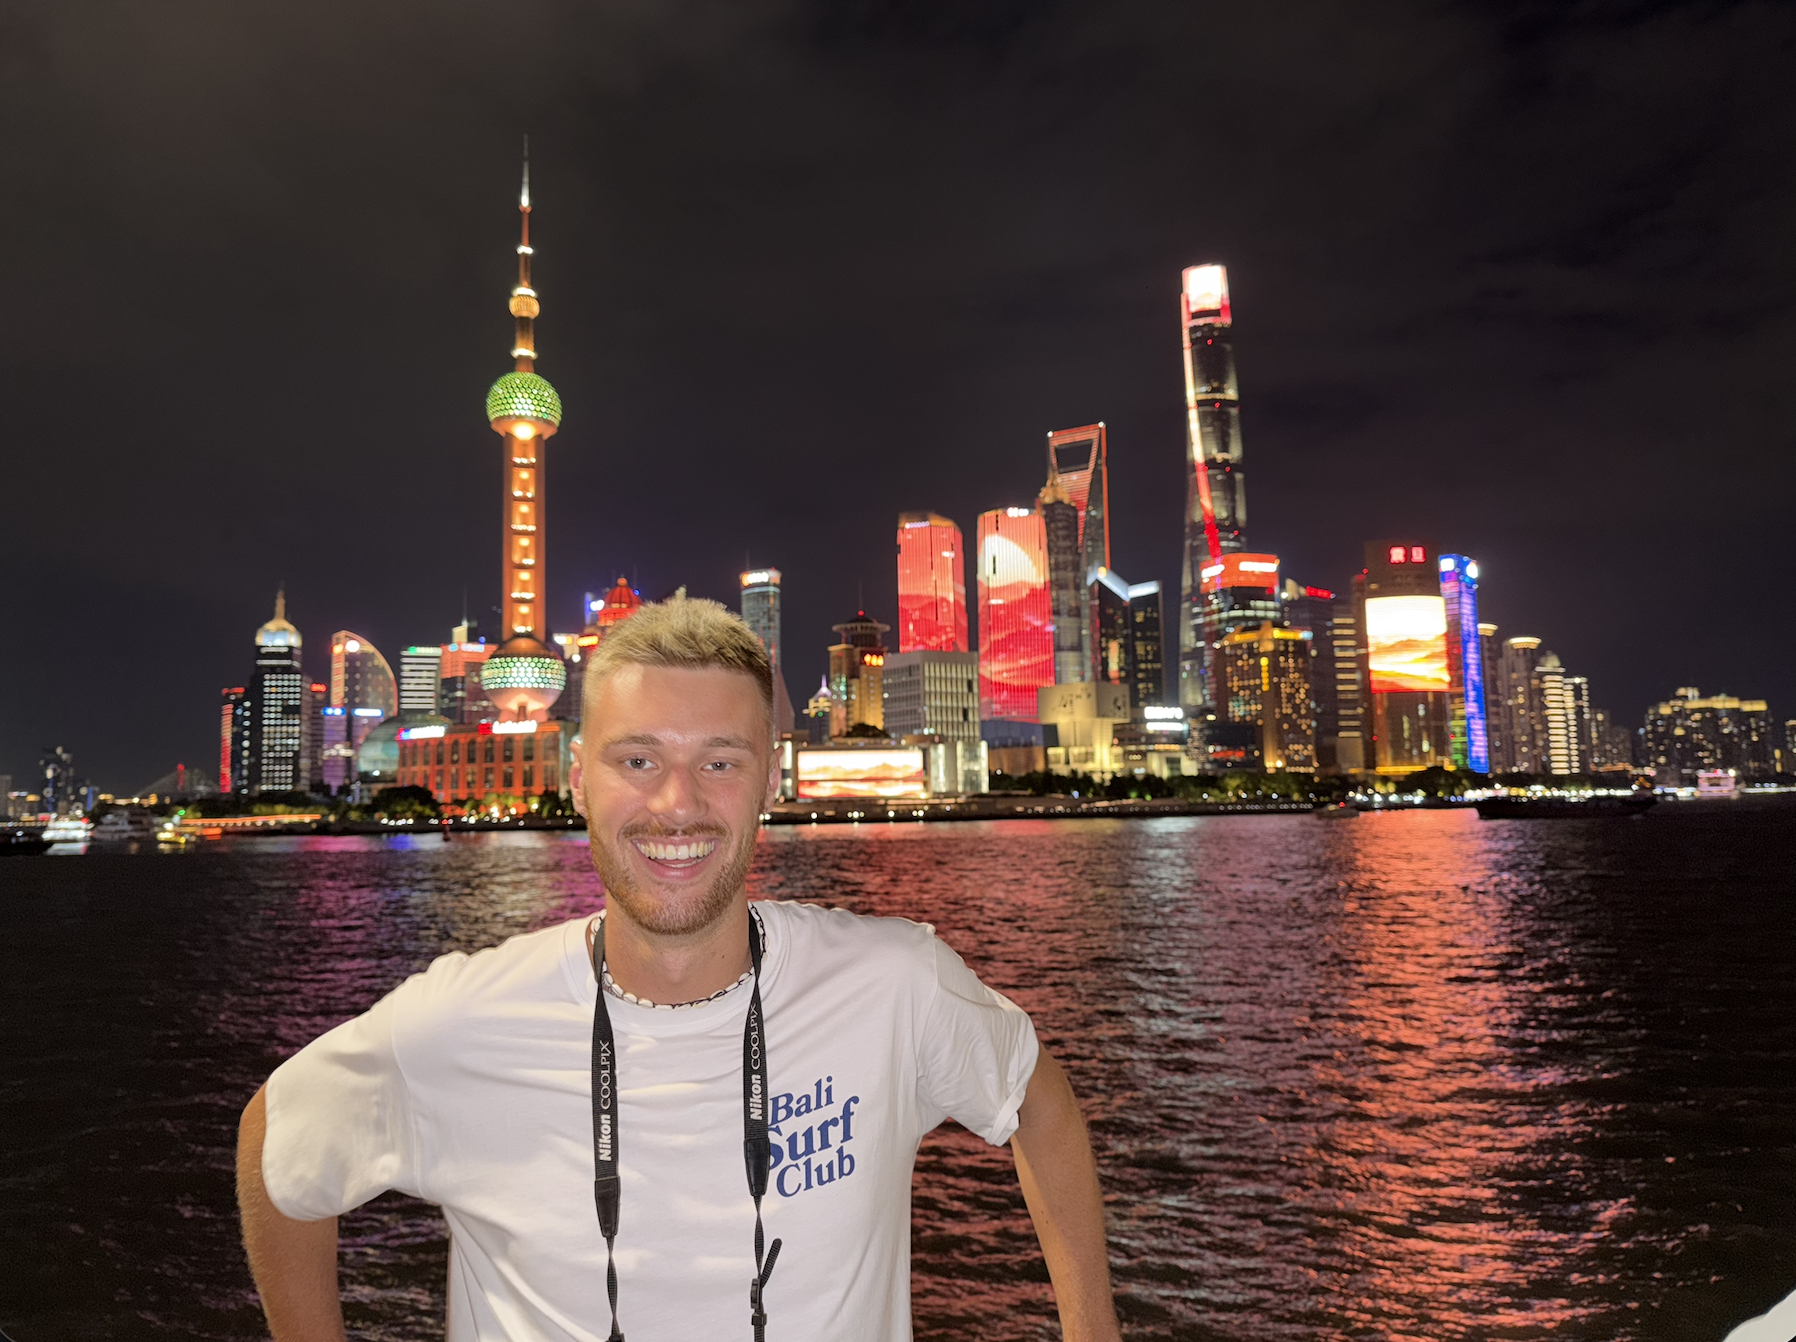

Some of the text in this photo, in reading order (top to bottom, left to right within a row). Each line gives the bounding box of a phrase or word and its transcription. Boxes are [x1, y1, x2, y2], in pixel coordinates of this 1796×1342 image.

[598, 1040, 612, 1161] Nikon COOLPIX
[750, 1003, 763, 1121] Nikon COOLPIX
[768, 1075, 834, 1127] Bali
[776, 1145, 856, 1198] Club
